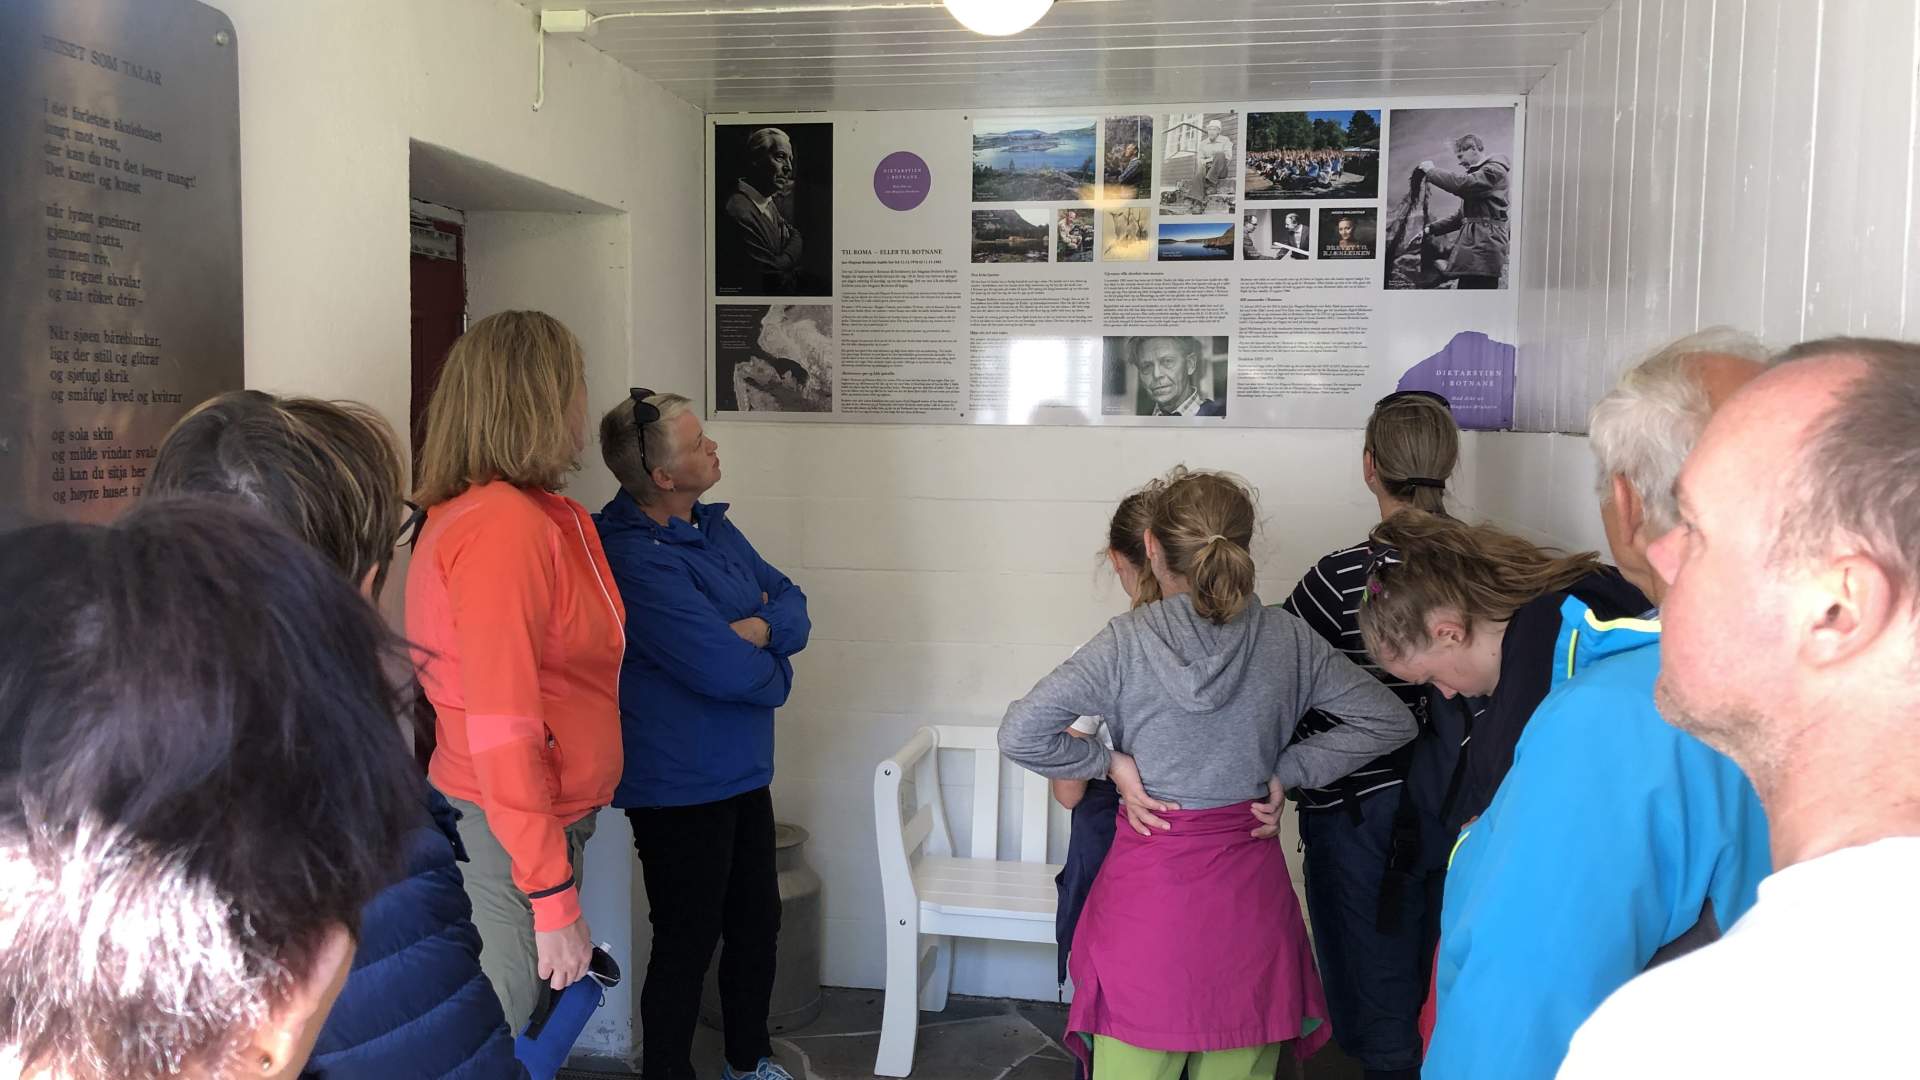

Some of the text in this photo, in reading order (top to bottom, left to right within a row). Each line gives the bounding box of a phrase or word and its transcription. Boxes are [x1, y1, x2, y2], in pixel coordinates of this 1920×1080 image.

[91, 50, 118, 71] SOM
[122, 60, 163, 86] TALAR
[75, 131, 95, 144] mot
[66, 145, 85, 162] kan
[89, 151, 101, 166] du
[123, 159, 138, 175] det
[99, 176, 112, 191] og
[70, 270, 103, 286] regnet
[48, 288, 61, 302] og
[74, 348, 90, 362] der
[116, 353, 128, 366] og
[50, 370, 64, 383] og
[104, 368, 129, 382] skrik
[1435, 369, 1502, 377] DIKTARSTIEN
[51, 390, 64, 403] og
[68, 387, 107, 405] småfugl
[111, 389, 134, 402] kved
[137, 393, 148, 405] og
[51, 426, 114, 444] og sola skin
[52, 450, 65, 464] og
[70, 446, 97, 460] milde
[101, 446, 132, 460] vindar
[52, 465, 147, 482] då kan du sitja her
[52, 490, 65, 505] og
[69, 487, 99, 504] høyre
[102, 485, 128, 499] huset
